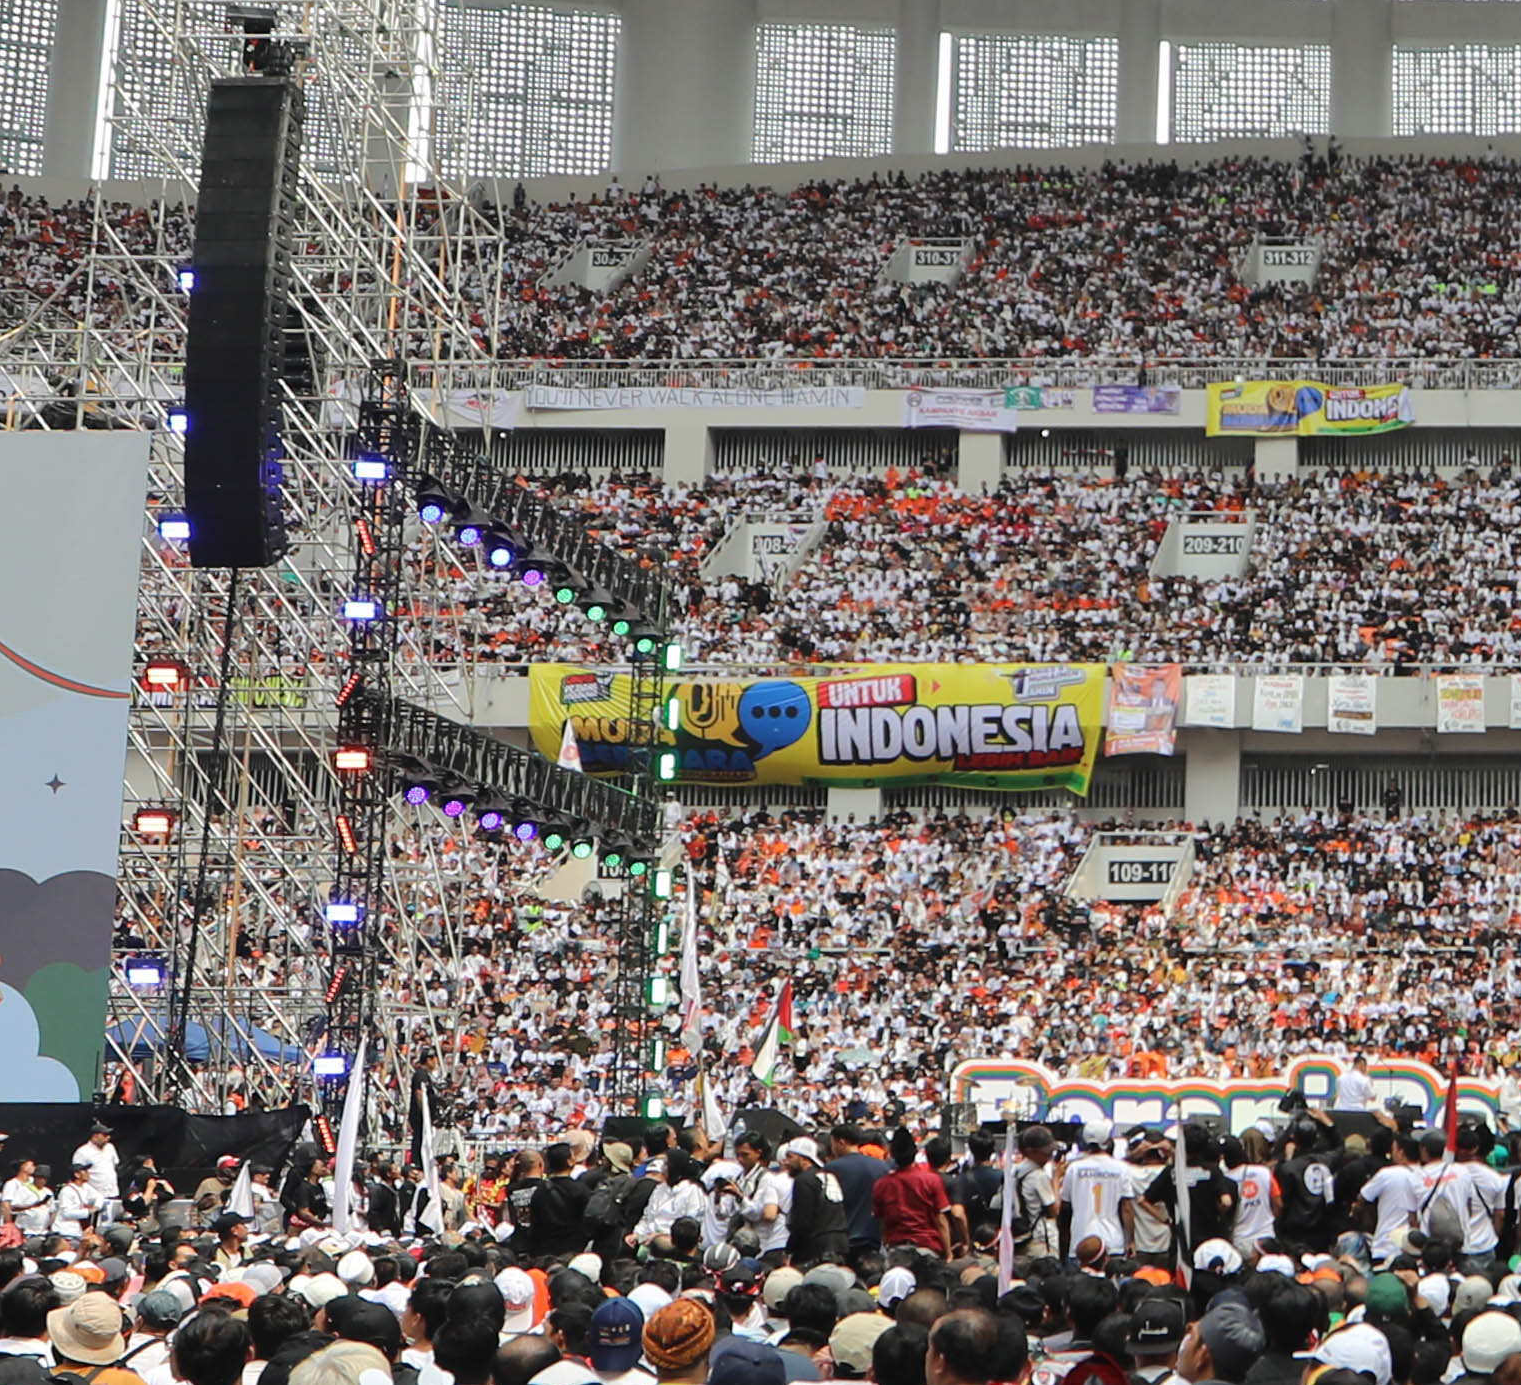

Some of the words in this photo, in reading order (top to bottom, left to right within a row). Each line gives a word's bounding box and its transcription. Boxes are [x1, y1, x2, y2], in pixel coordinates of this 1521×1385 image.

[917, 251, 958, 265] 310-31
[1264, 251, 1313, 265] 311-312
[580, 388, 641, 408] NEVER
[649, 388, 703, 408] WALK
[711, 388, 776, 408] ALONE
[1184, 536, 1245, 554] 209-210
[827, 677, 903, 707] UNTUK
[819, 703, 1085, 764] INDONESIA
[1110, 862, 1176, 883] 109-110
